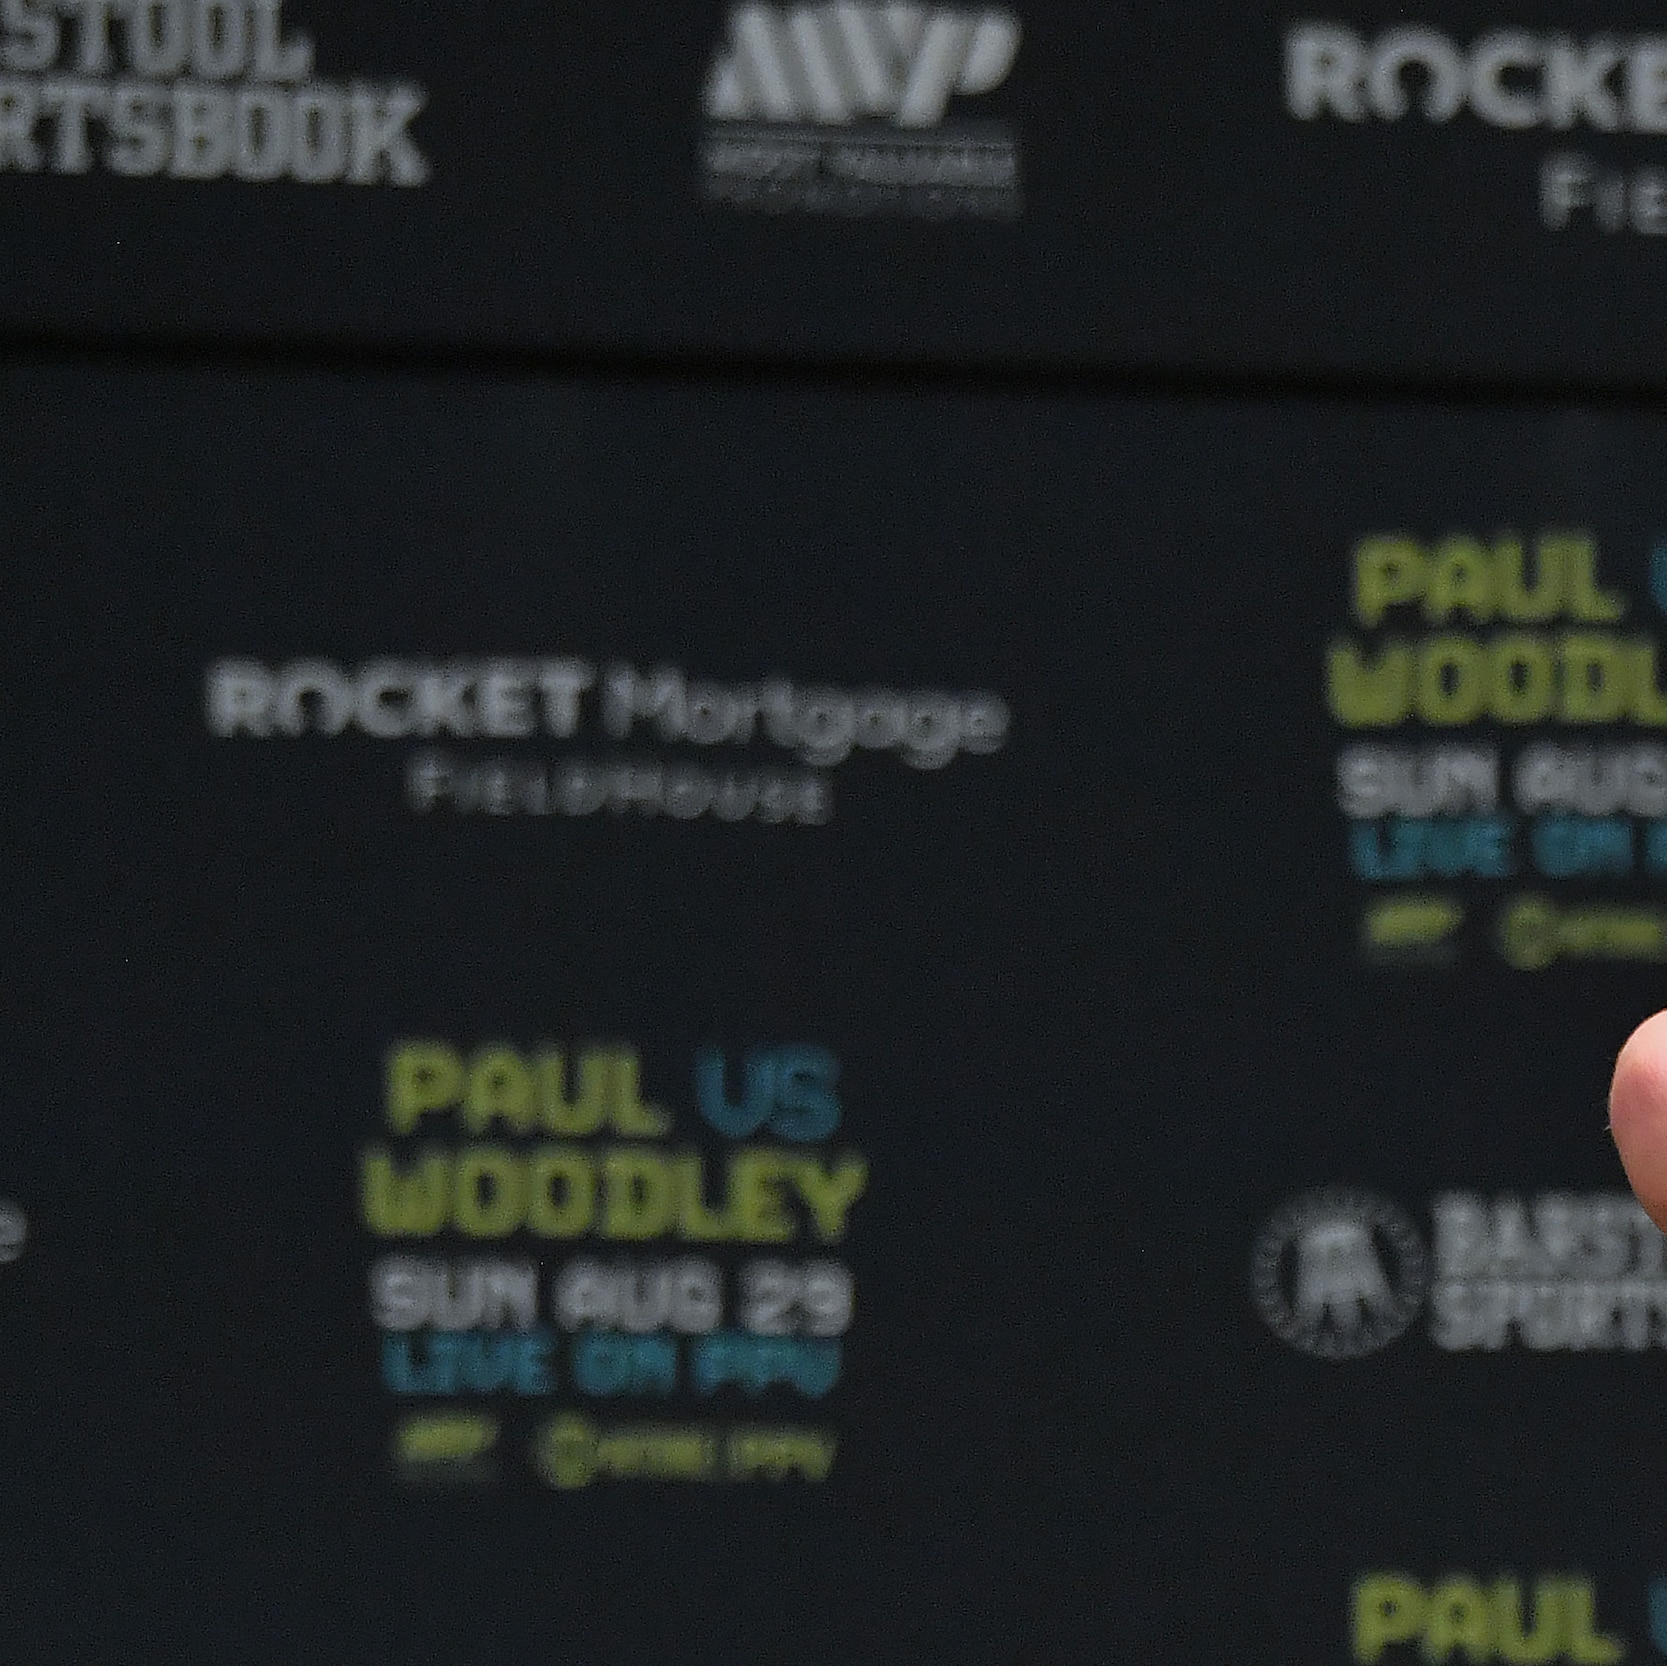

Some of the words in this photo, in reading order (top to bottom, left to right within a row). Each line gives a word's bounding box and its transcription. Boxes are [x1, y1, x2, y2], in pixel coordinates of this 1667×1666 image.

[1352, 530, 1628, 630] PAUL
[206, 654, 594, 740] ROCKET
[604, 661, 1010, 771] Mortgage
[1336, 740, 1500, 818] SUN
[383, 1039, 672, 1139] PAUL
[358, 1141, 869, 1244] WOODLEY
[367, 1254, 541, 1332] SUN
[553, 1254, 725, 1334] AUG
[737, 1254, 855, 1338] 29
